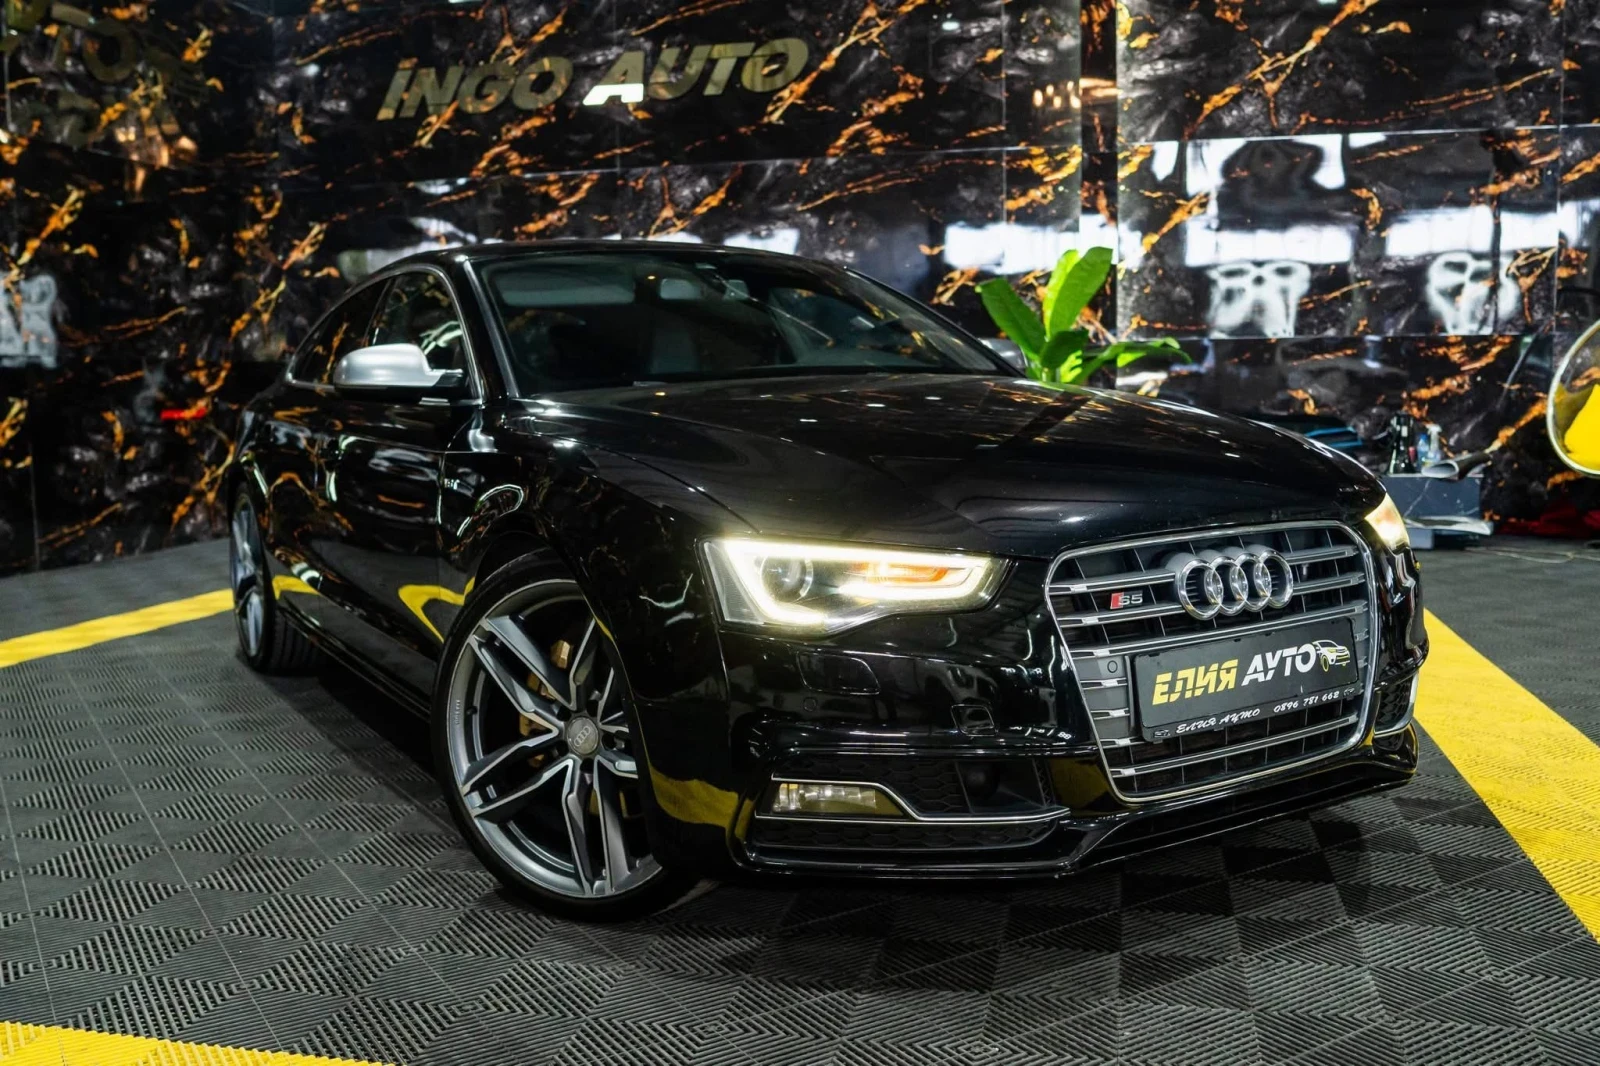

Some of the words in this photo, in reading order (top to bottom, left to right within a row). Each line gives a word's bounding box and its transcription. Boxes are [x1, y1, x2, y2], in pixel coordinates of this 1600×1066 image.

[376, 57, 574, 121] INGO
[582, 37, 808, 105] AUTO
[1118, 593, 1144, 606] S5
[1152, 659, 1239, 705] ЕЛИЯ
[1241, 643, 1316, 686] АУТО
[1273, 700, 1299, 713] 0896
[1303, 696, 1319, 706] 781
